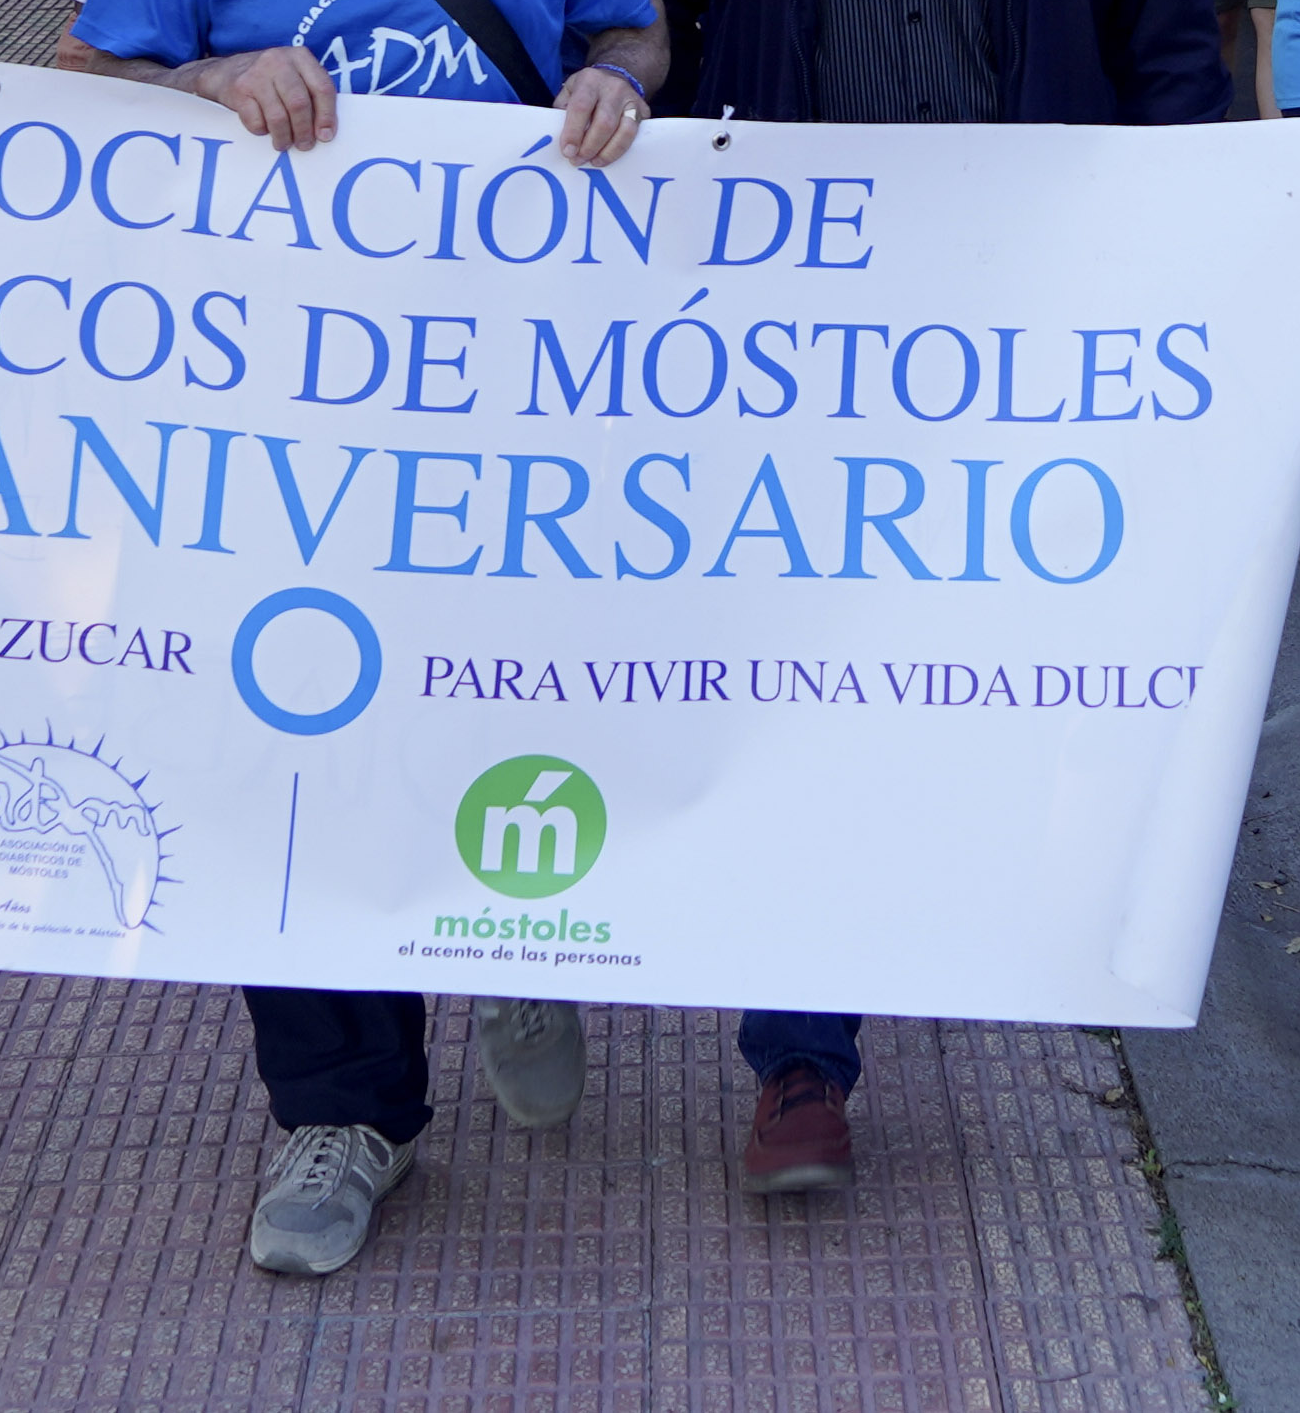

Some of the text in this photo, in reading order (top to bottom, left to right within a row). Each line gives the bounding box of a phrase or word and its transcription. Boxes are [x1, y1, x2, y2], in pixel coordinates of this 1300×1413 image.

[698, 176, 875, 270] DE
[290, 302, 478, 414] DE
[516, 287, 1214, 424] MÓSTOLES
[421, 654, 569, 704] PARA
[583, 659, 730, 704] VIVIR
[748, 661, 867, 705] UNA
[880, 662, 1019, 707] VIDA
[0, 839, 86, 854] ASOCIACIÓN DE
[67, 857, 82, 866] DE
[9, 865, 68, 879] MÓSTOLES
[434, 906, 612, 944] móstoles
[398, 941, 642, 967] el acento de las personas
